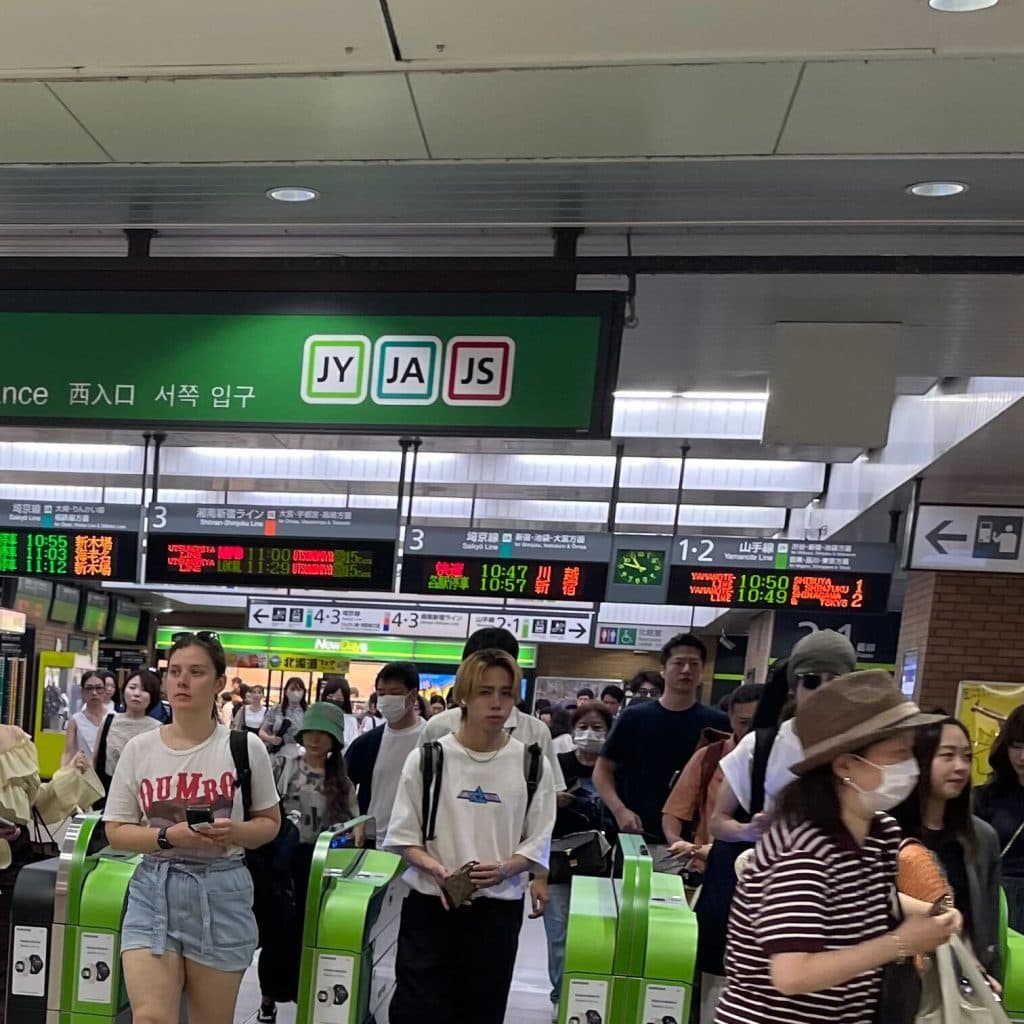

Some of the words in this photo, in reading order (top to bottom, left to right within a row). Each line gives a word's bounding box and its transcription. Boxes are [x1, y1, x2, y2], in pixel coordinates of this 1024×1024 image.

[316, 355, 355, 385] JY
[386, 357, 425, 385] JA
[461, 357, 495, 386] JS
[68, 382, 136, 408] 西入口
[155, 382, 201, 408] 서쪽
[211, 383, 257, 409] 입구
[152, 506, 167, 529] 3
[27, 534, 68, 548] 10:55
[409, 529, 424, 550] 3
[739, 542, 774, 553] 山手線
[27, 547, 67, 561] 11:03
[247, 547, 291, 562] 11:00
[26, 560, 67, 574] 11:12
[247, 561, 290, 576] 11:29
[480, 563, 528, 579] 10:47
[479, 578, 527, 593] 10:57
[739, 574, 789, 590] 10:50
[856, 579, 863, 593] 1
[738, 588, 788, 604] 10:49
[851, 593, 863, 608] 2
